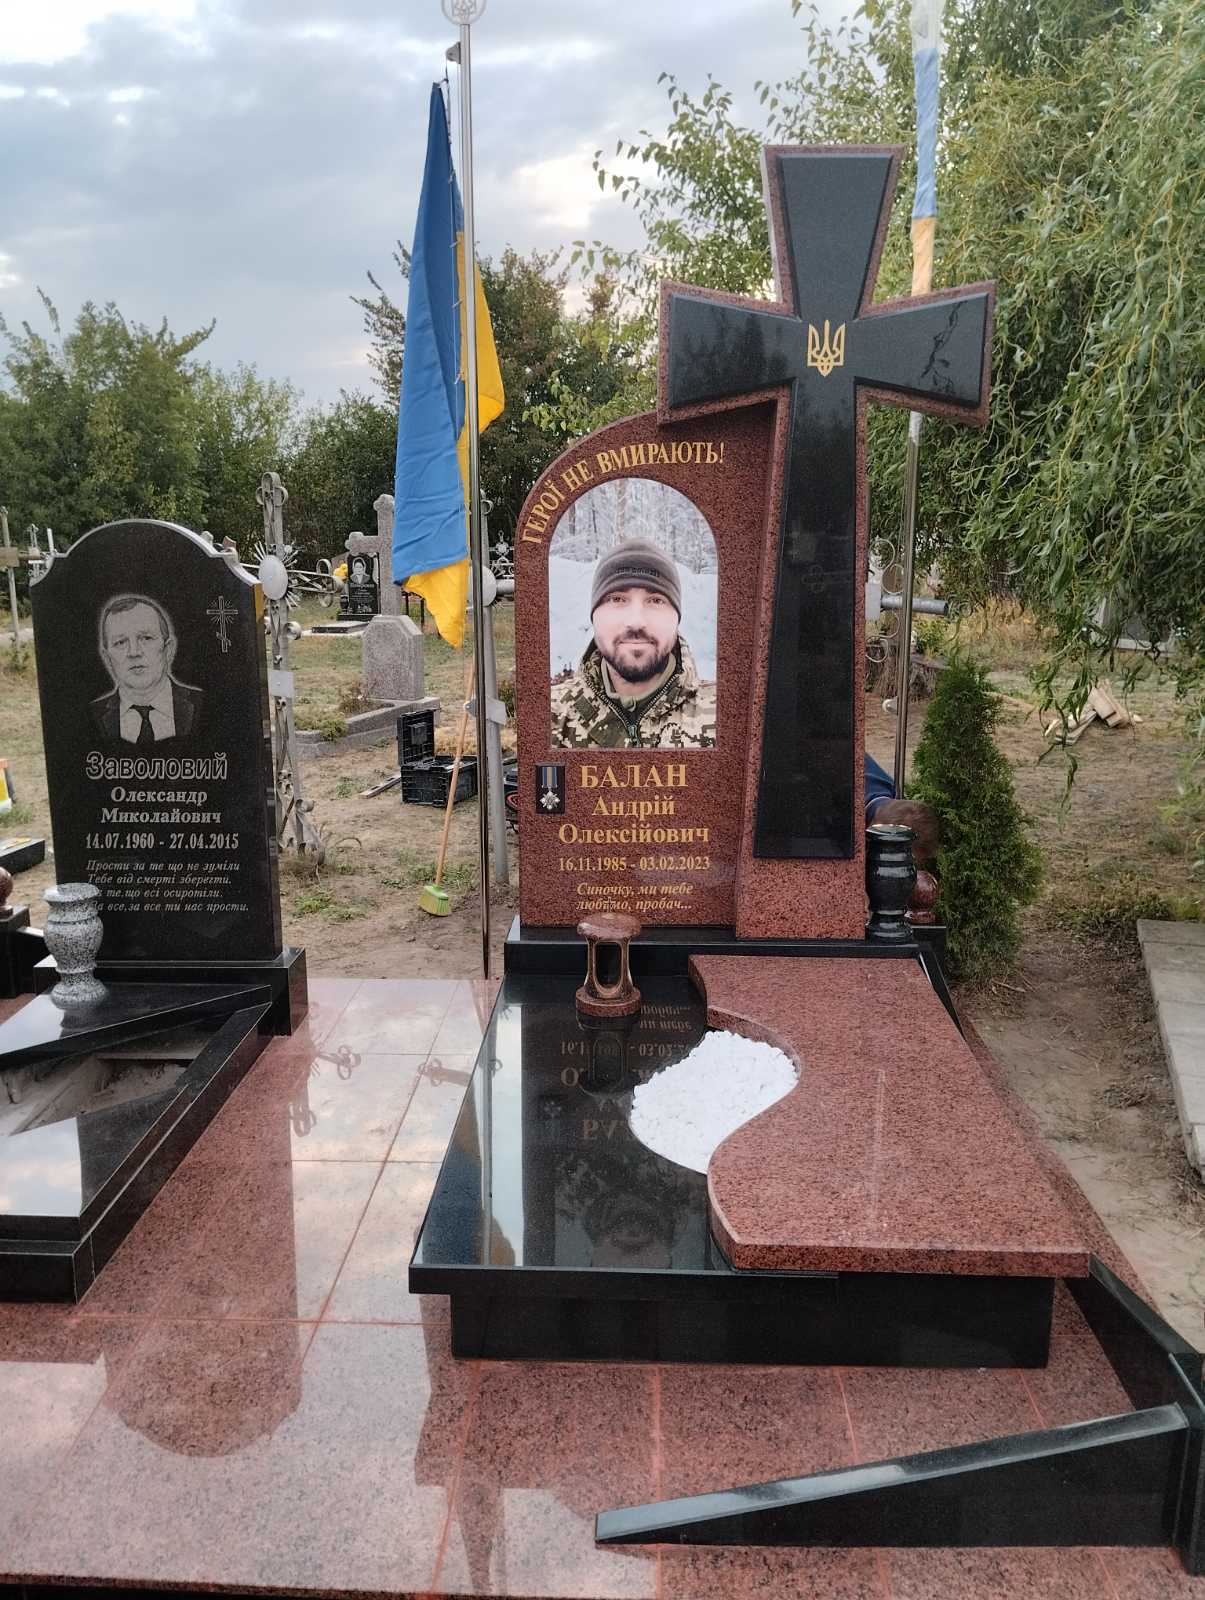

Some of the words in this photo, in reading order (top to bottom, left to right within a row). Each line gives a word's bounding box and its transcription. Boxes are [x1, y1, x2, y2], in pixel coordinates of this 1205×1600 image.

[521, 479, 566, 544] ГЕРОЇ
[560, 460, 594, 493] НЕ
[596, 441, 725, 474] ВМИРАЮТЬ!
[86, 751, 228, 780] Заволовий
[579, 764, 689, 788] БАЛАН
[110, 786, 208, 806] Олександр
[101, 807, 222, 823] Миколайович
[591, 795, 676, 821] Андрій
[86, 833, 155, 849] 14.07.1960
[170, 833, 239, 849] 27.04.2015
[558, 823, 710, 844] Олексійович
[86, 860, 130, 873] Прости
[133, 863, 145, 871] за
[150, 863, 164, 871] те
[168, 863, 184, 873] що
[187, 863, 200, 871] не
[203, 860, 240, 873] зуміли
[559, 857, 627, 871] 16.11.1985
[639, 856, 711, 871] 03.02.2023
[87, 873, 113, 884] Тебе
[116, 873, 134, 884] від
[137, 873, 176, 887] смерті
[144, 887, 160, 898] всі
[576, 882, 635, 897] Синочку,
[638, 885, 658, 895] ми
[661, 882, 694, 895] тебе
[144, 902, 162, 912] все
[165, 902, 181, 912] ти
[184, 902, 203, 912] нас
